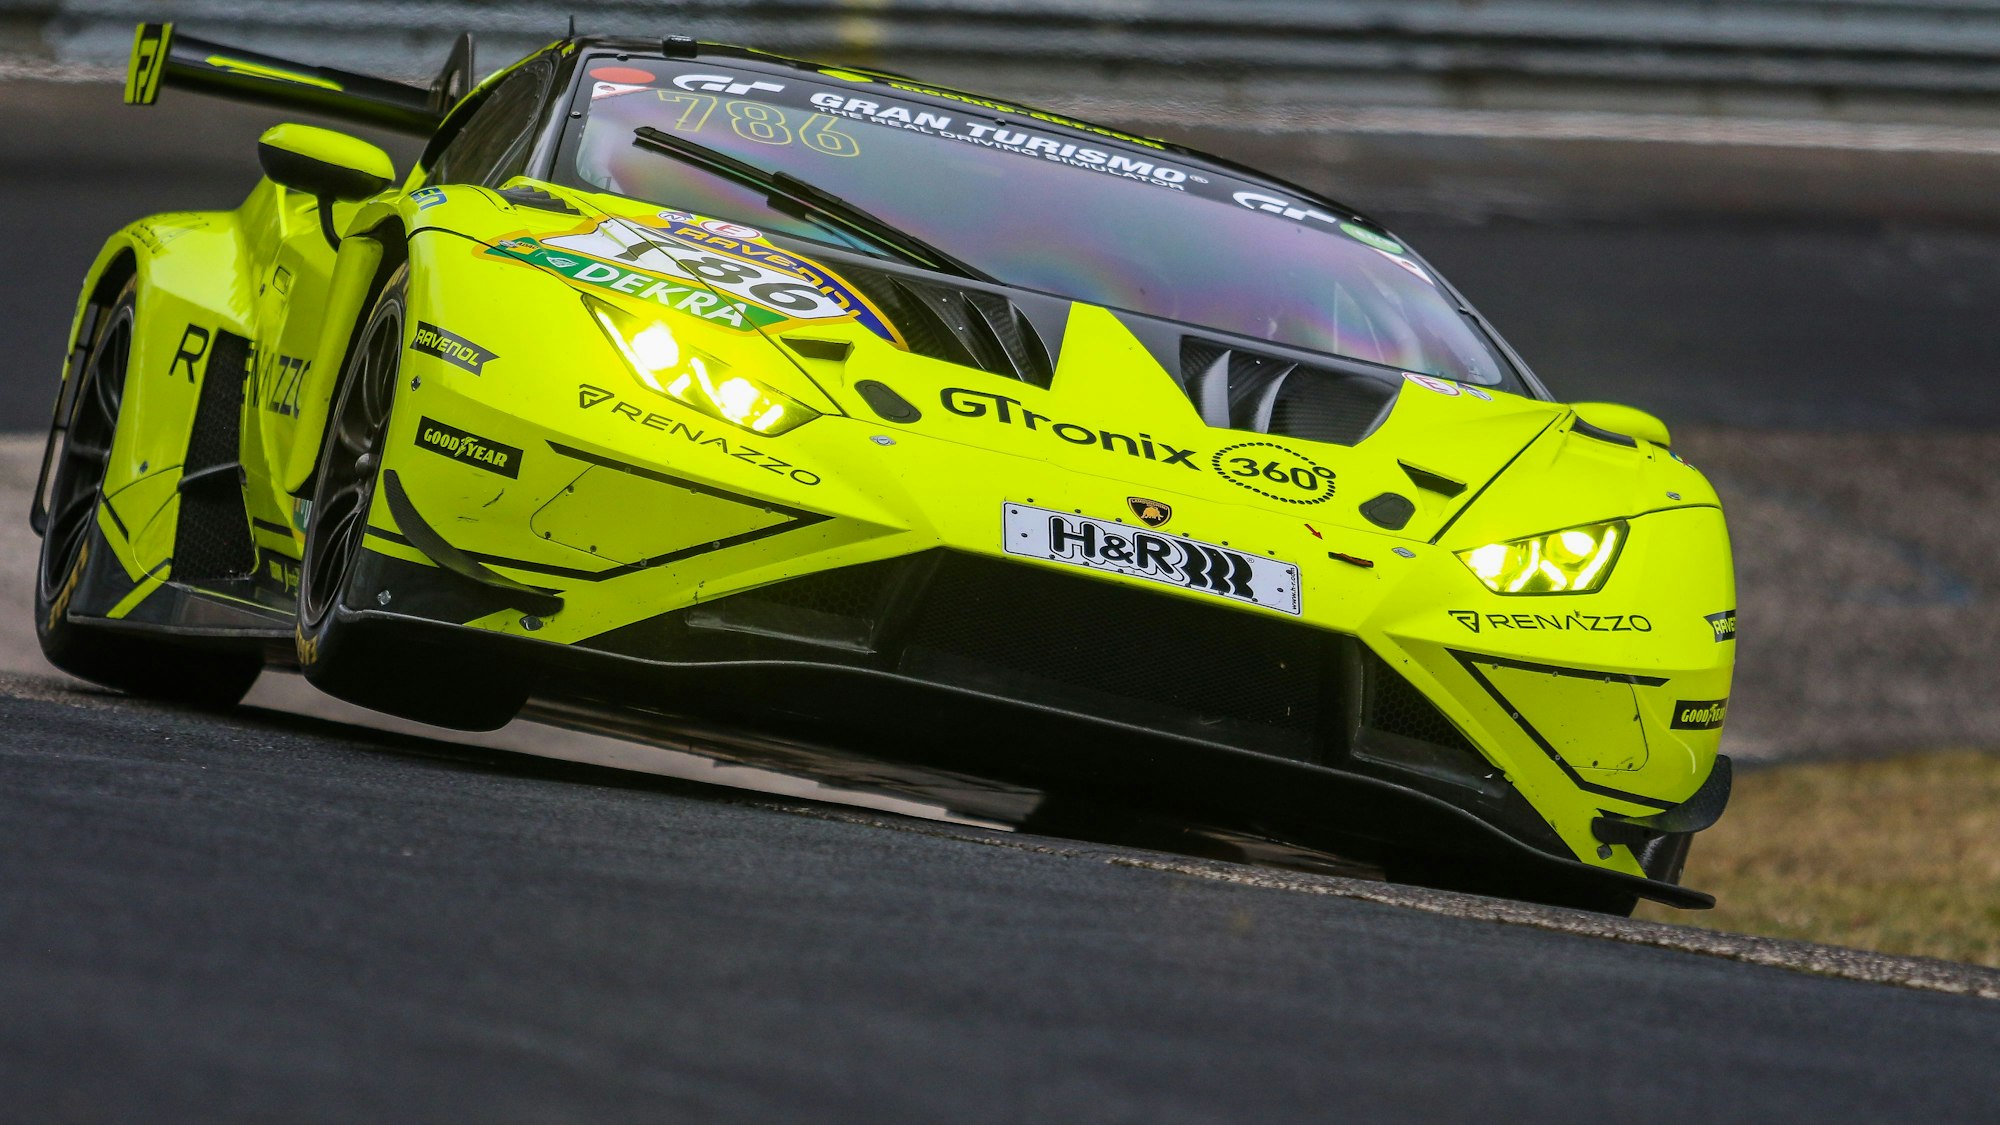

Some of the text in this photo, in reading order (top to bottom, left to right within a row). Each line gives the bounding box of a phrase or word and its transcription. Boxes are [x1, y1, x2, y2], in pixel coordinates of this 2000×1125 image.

[657, 88, 860, 157] 786
[810, 92, 1188, 184] GRAN TURISMO
[814, 105, 1185, 191] THE REAL DRIVING SIMULATOR
[573, 262, 748, 328] DEKRA
[674, 227, 862, 319] RAVENOL
[415, 328, 479, 367] RAVENOL
[423, 428, 508, 468] GOODYEAR
[611, 401, 821, 486] RENAZZO
[939, 386, 1203, 472] GTronix
[1049, 514, 1187, 581] H&R
[1485, 613, 1652, 632] RENAZZO
